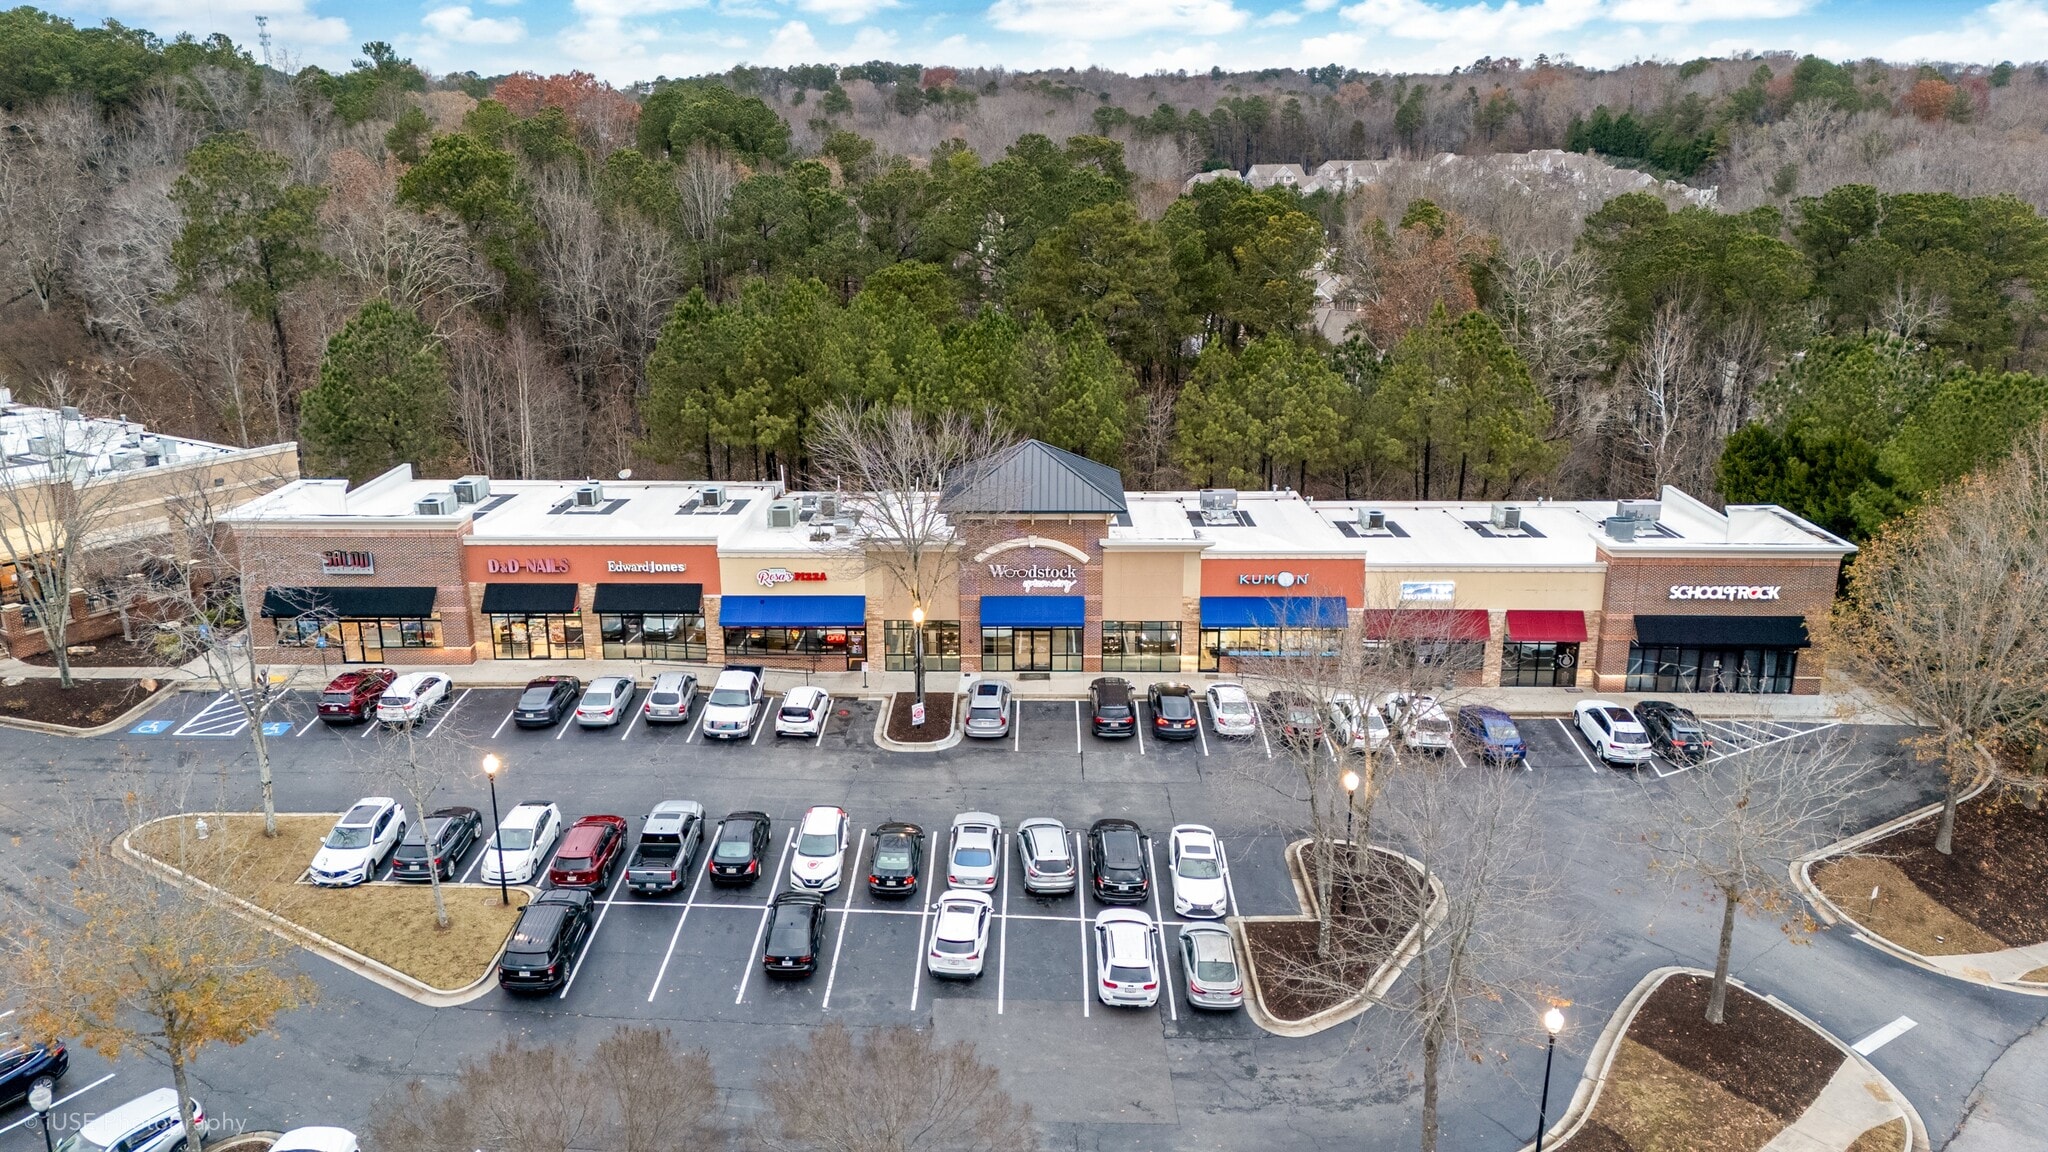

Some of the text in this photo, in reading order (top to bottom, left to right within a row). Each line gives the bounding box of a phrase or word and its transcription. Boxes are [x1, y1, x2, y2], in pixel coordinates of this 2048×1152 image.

[487, 558, 570, 573] D&D NAILS
[607, 561, 687, 573] Edward Jones
[988, 564, 1077, 578] Woodstock
[757, 568, 827, 587] Rosa's PIZZA
[1239, 571, 1309, 587] KUMON
[1668, 586, 1727, 599] SCHOOL
[1737, 586, 1781, 599] ROCK
[827, 634, 846, 642] OPEN
